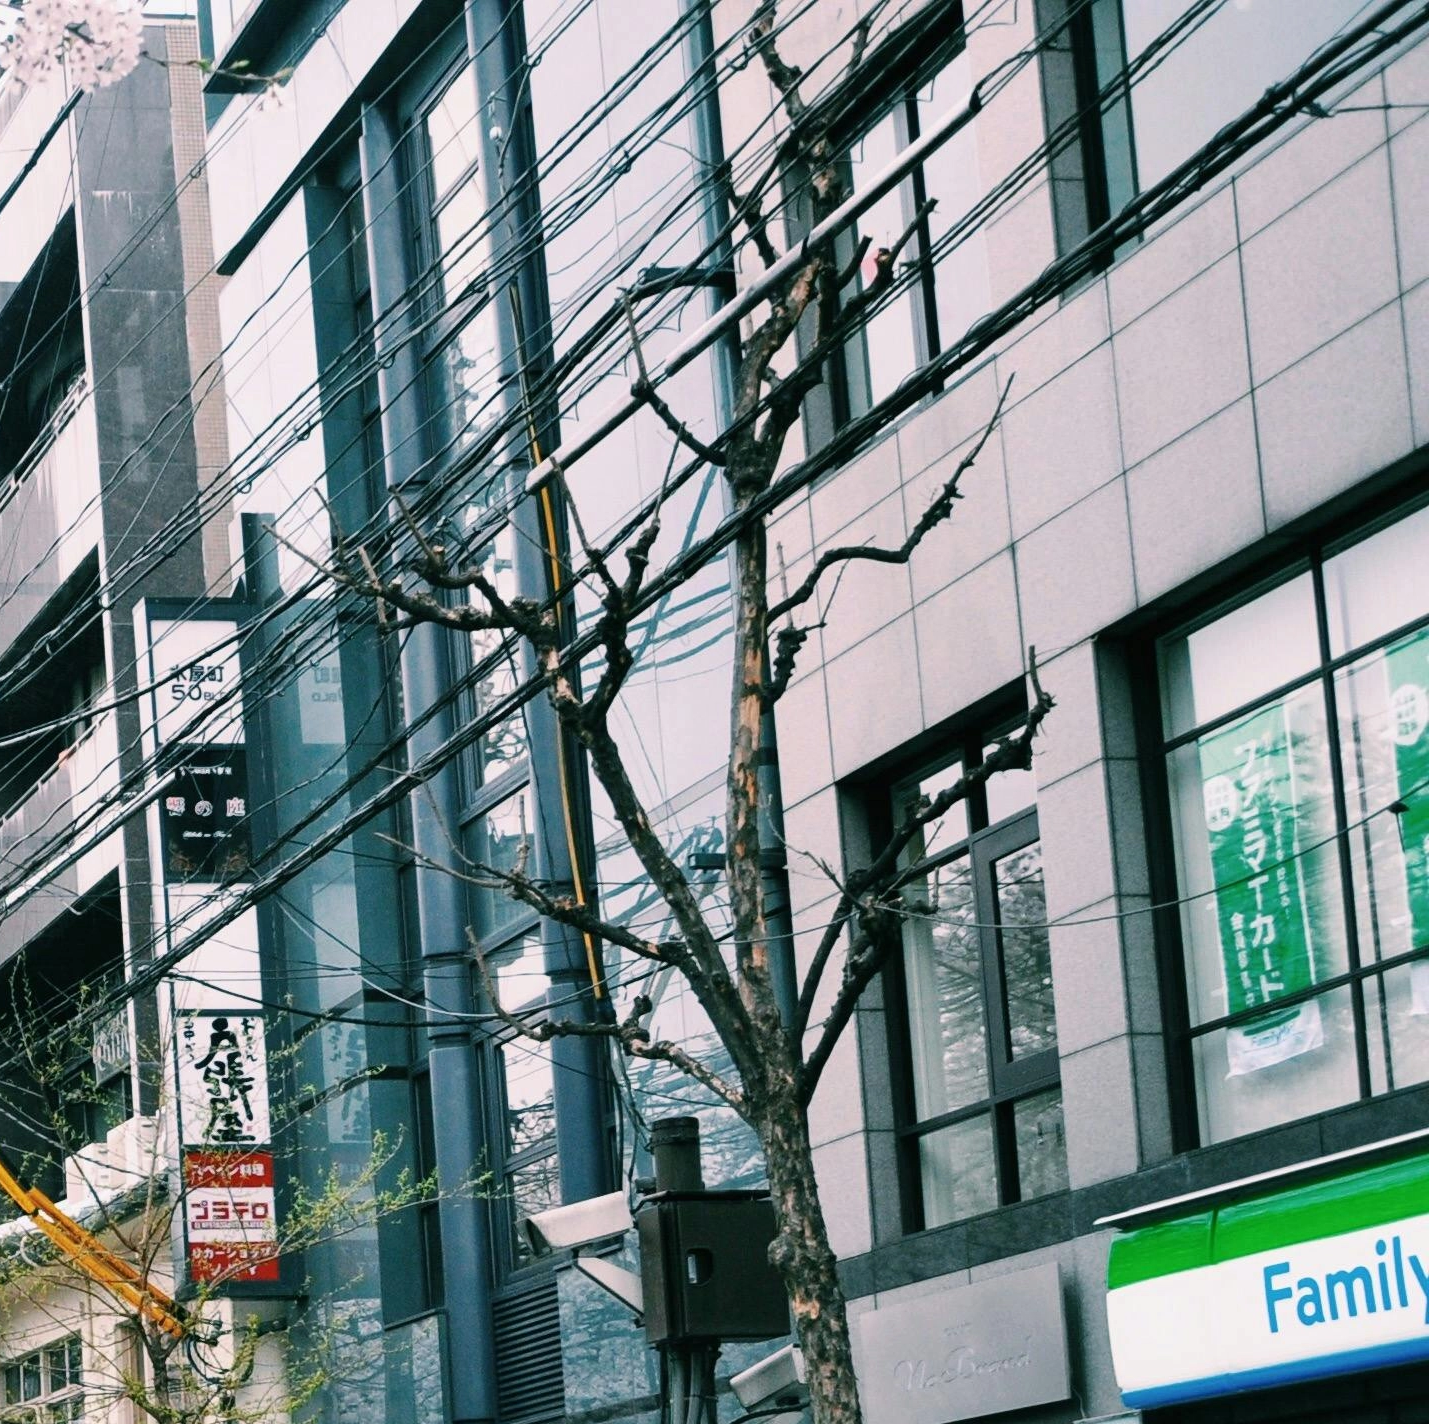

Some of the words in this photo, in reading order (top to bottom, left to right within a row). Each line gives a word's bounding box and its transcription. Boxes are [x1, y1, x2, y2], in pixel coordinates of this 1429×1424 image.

[190, 1200, 269, 1220] プラテロ
[1263, 1236, 1429, 1334] Family
